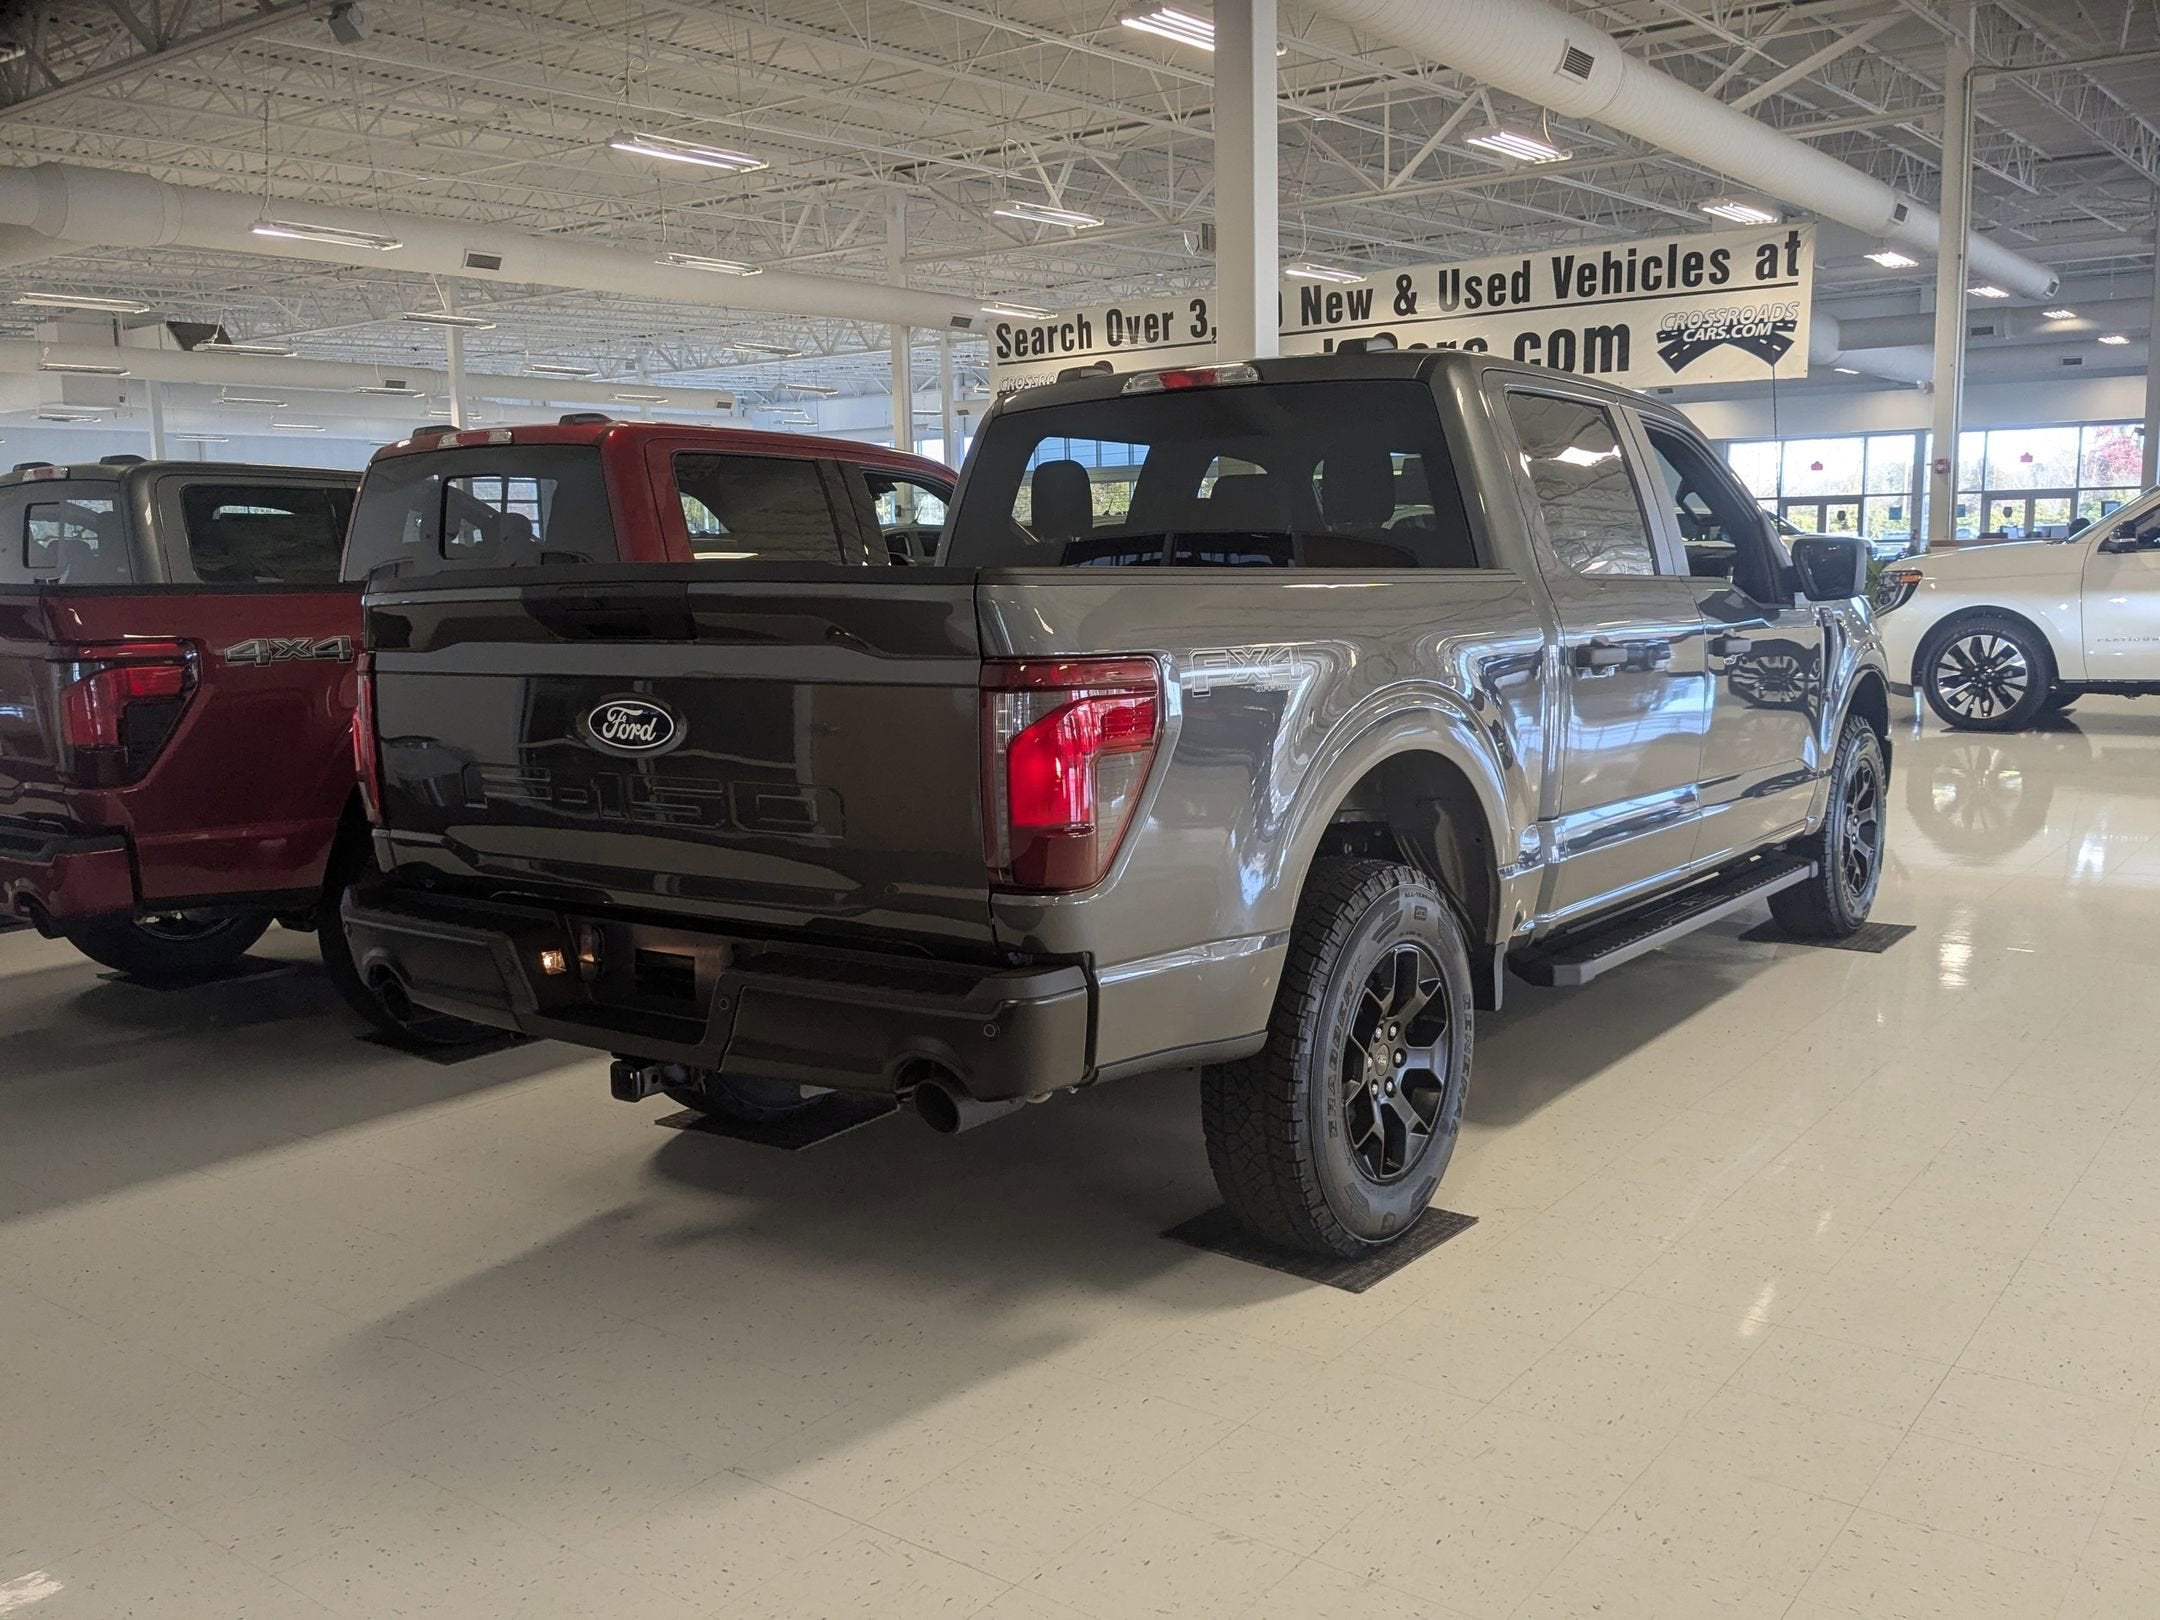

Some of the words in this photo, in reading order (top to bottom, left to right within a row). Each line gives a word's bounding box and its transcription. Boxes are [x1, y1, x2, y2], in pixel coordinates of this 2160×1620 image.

[996, 313, 1093, 359] Search
[1106, 308, 1174, 347] Over
[1302, 283, 1374, 326] New
[1393, 274, 1418, 317] &
[1438, 260, 1531, 312] Used
[1552, 243, 1731, 300] Vehicles
[1755, 230, 1801, 281] at
[1661, 301, 1800, 332] CROSSROADS
[1682, 322, 1774, 342] CARS.COM
[1000, 373, 1057, 391] CROSSRO
[1189, 643, 1304, 698] FX4
[602, 706, 658, 741] Ford
